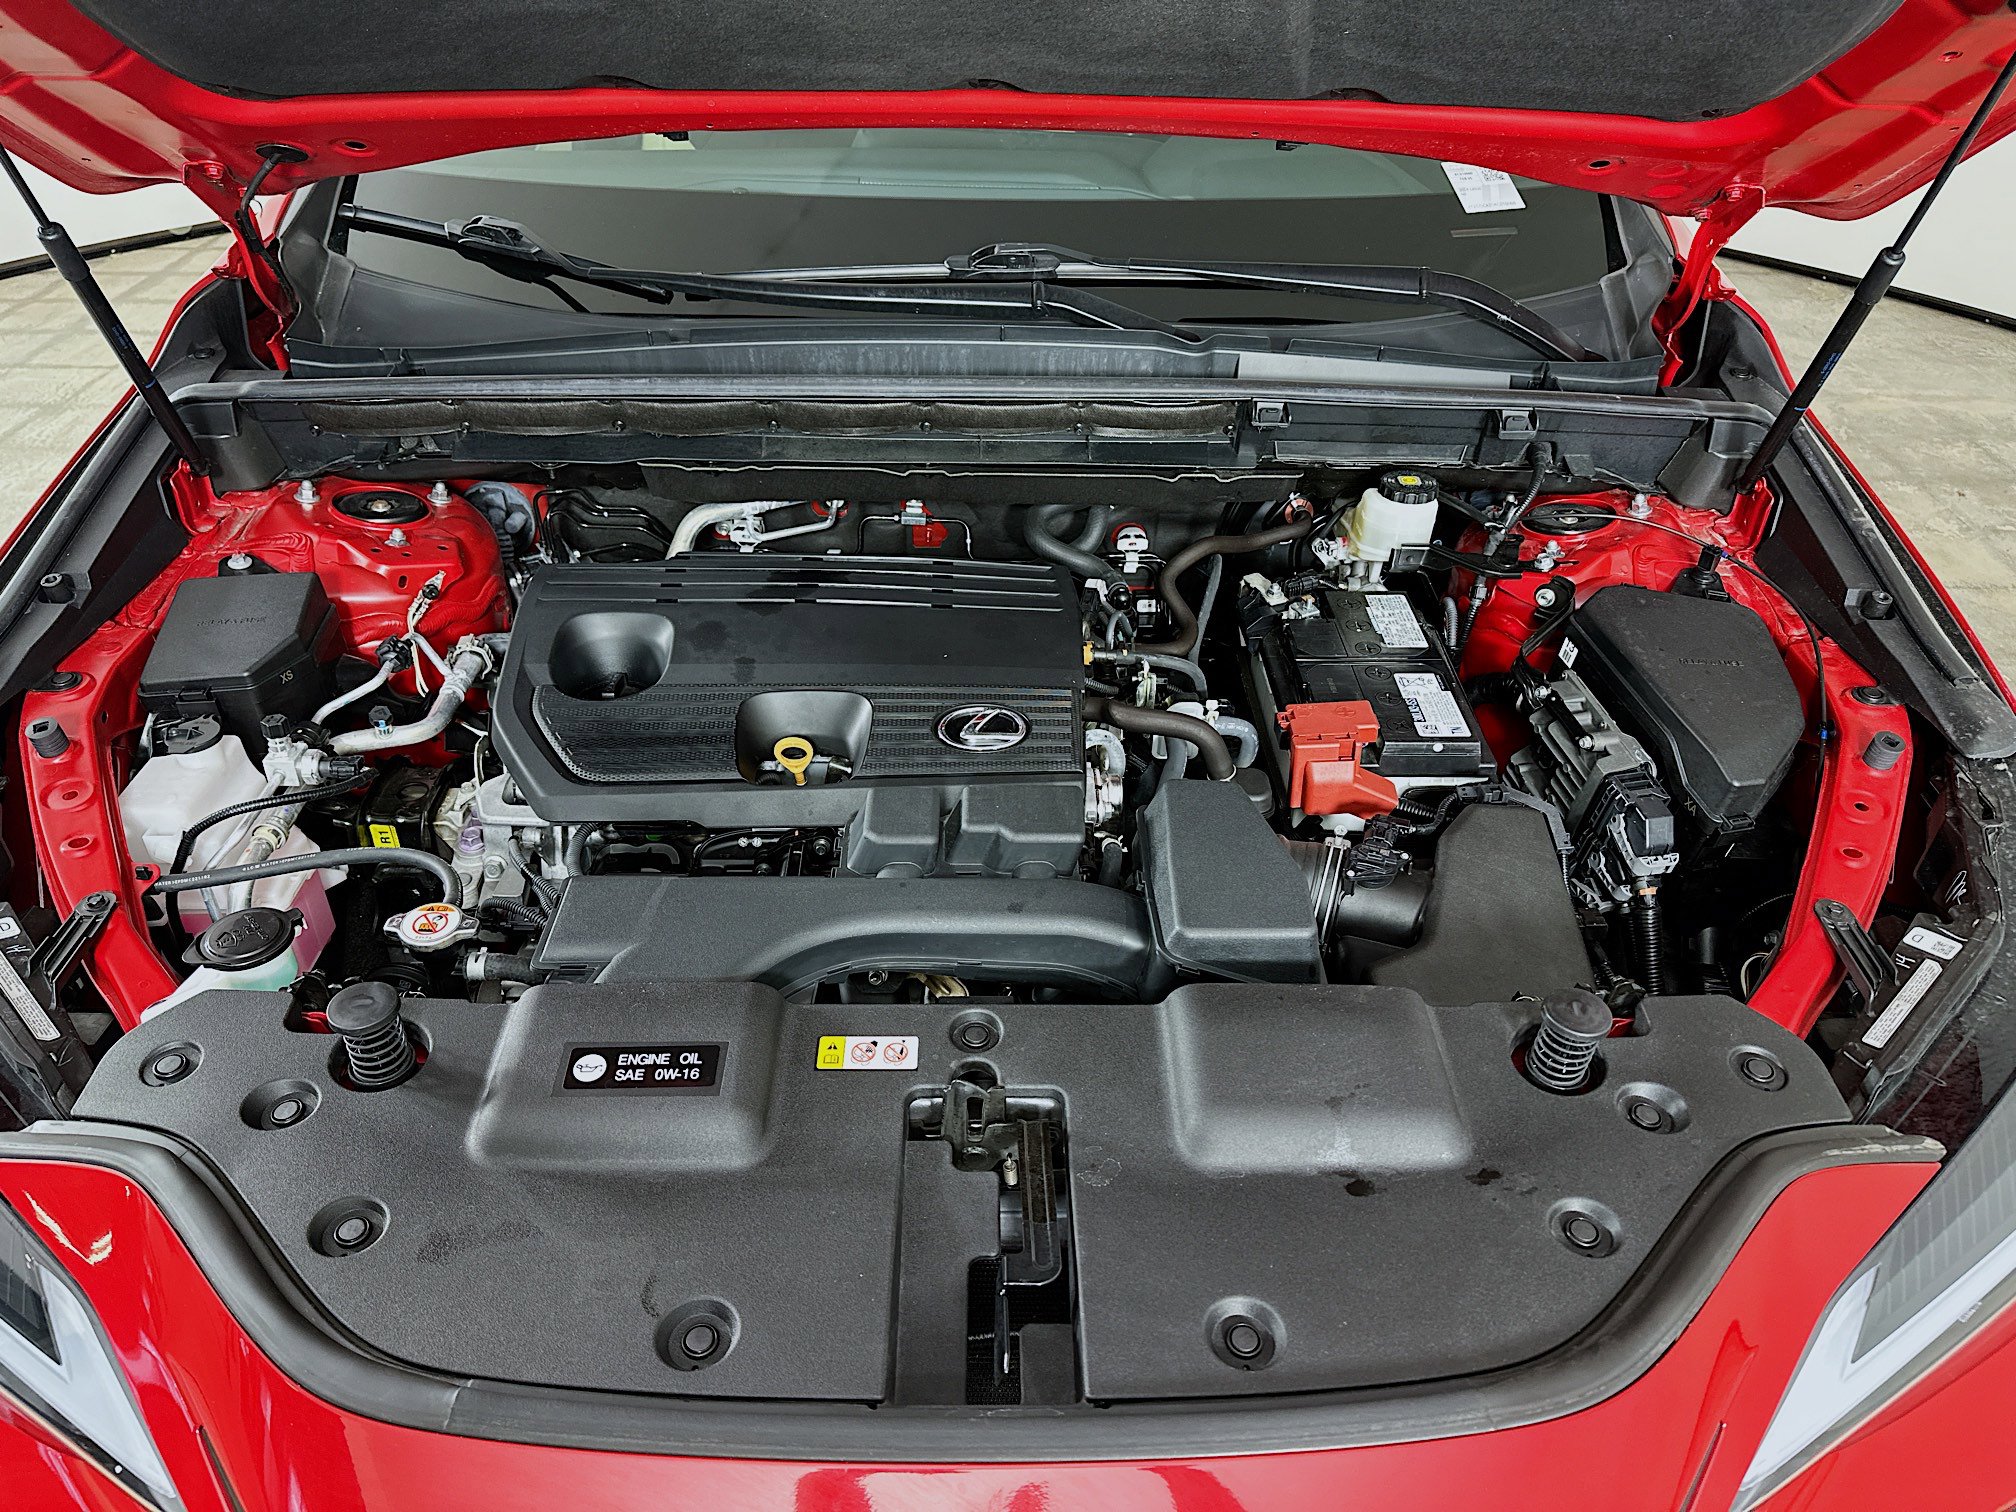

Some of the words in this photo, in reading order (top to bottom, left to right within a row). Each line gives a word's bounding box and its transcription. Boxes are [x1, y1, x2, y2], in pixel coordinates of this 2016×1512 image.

[279, 669, 294, 685] XS
[617, 1053, 672, 1066] ENGINE
[679, 1052, 703, 1065] OIL
[614, 1068, 646, 1081] SAE
[654, 1067, 701, 1081] 0W-16
